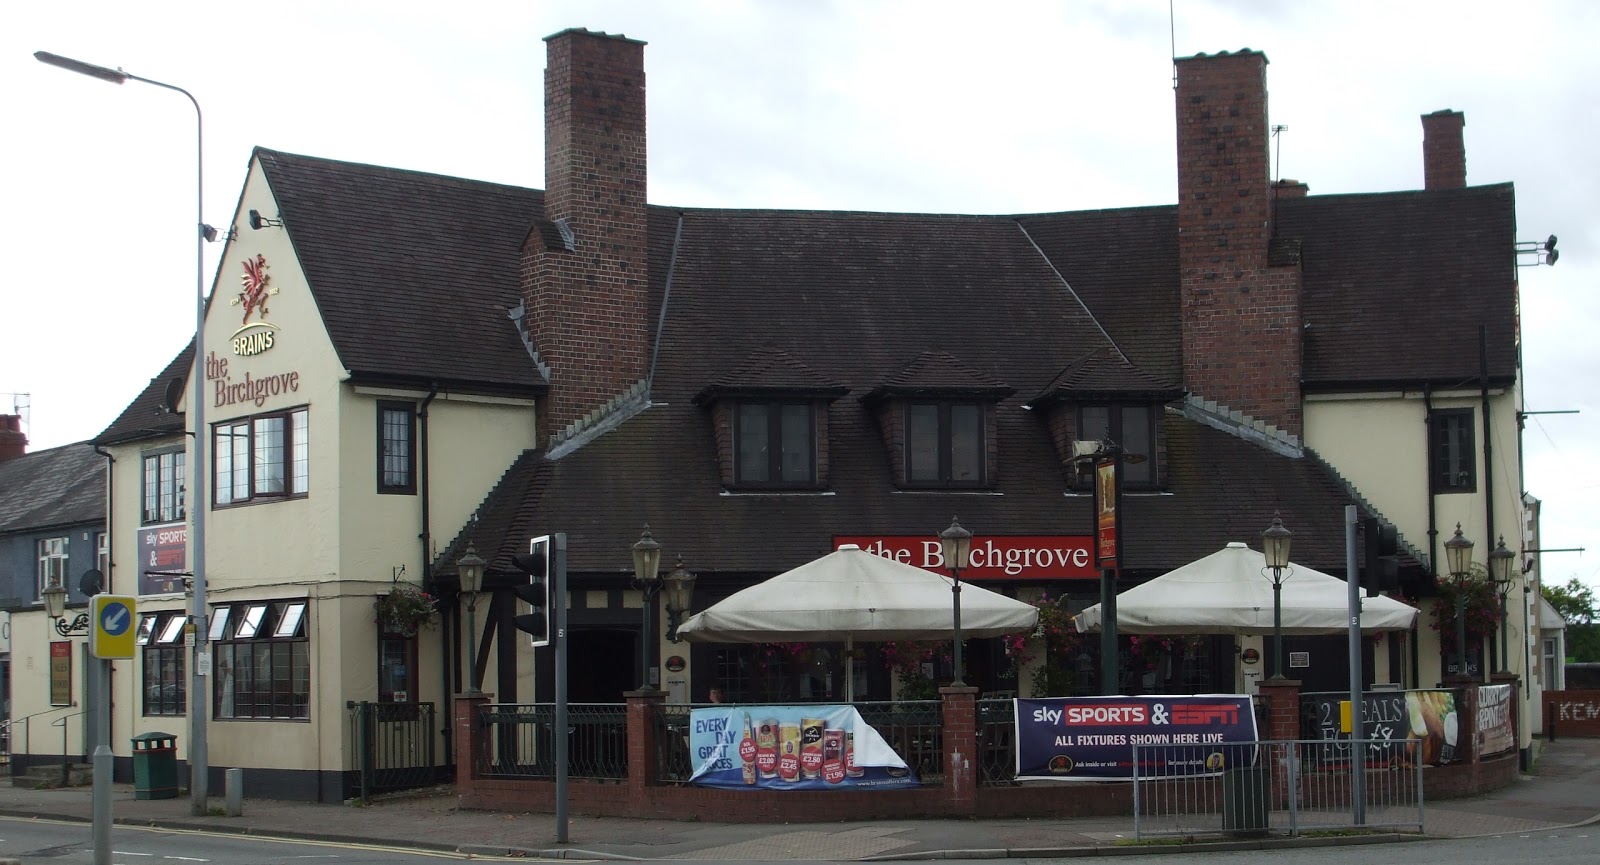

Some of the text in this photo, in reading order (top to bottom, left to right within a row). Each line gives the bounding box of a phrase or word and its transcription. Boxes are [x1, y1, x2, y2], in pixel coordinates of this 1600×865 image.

[233, 331, 275, 356] BRAINS
[205, 351, 228, 380] the
[214, 371, 299, 407] Birchgrove
[146, 530, 187, 547] sky SPORTS
[150, 550, 158, 567] &
[866, 540, 1089, 575] the Bchgrove
[1448, 664, 1478, 672] BRINS
[1033, 703, 1238, 725] sky SPORTS & ESPN
[1321, 699, 1403, 726] 2 EALS
[696, 717, 728, 733] EVERY
[715, 731, 736, 744] DAY
[1055, 733, 1223, 746] ALL FIXTURES SHOWN HERE LIVE
[1322, 723, 1394, 751] FO £8
[705, 758, 733, 770] ICES
